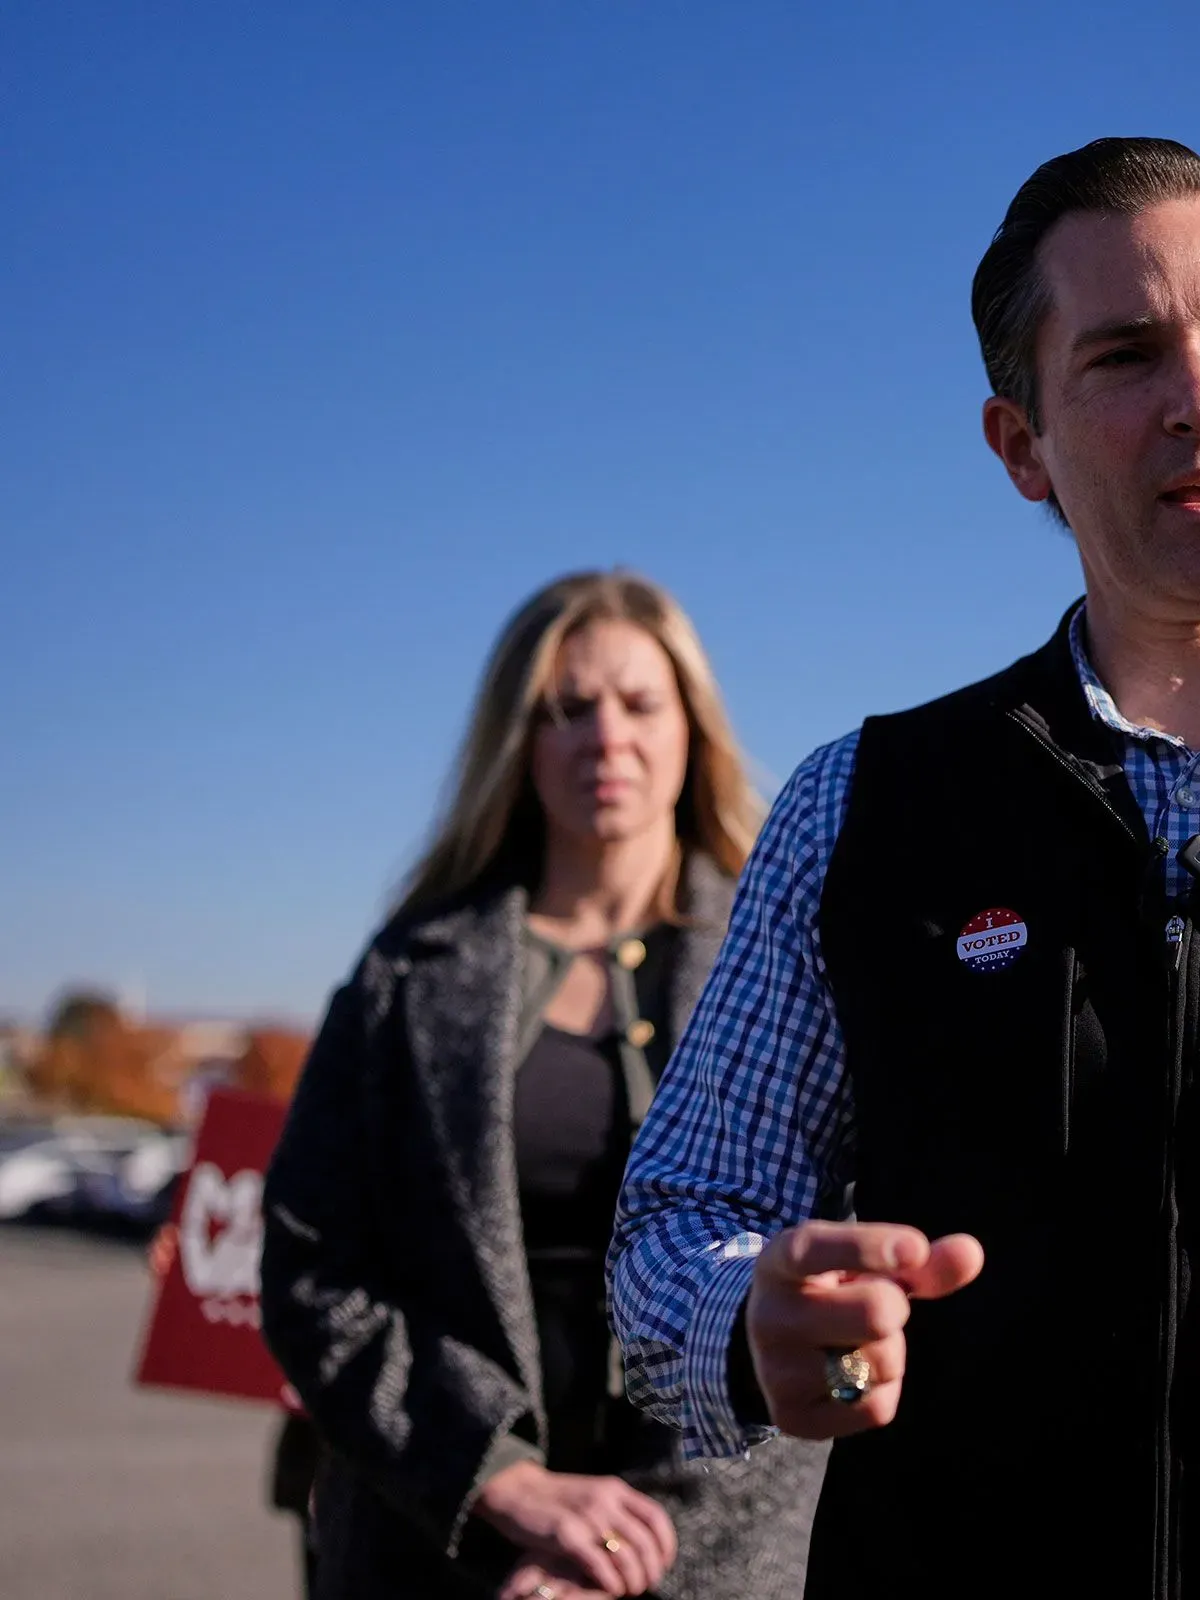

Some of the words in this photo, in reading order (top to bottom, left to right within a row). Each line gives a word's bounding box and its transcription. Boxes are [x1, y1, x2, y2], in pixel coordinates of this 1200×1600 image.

[985, 917, 994, 929] I
[962, 931, 1021, 952] VOTED
[974, 950, 1010, 964] TODAY
